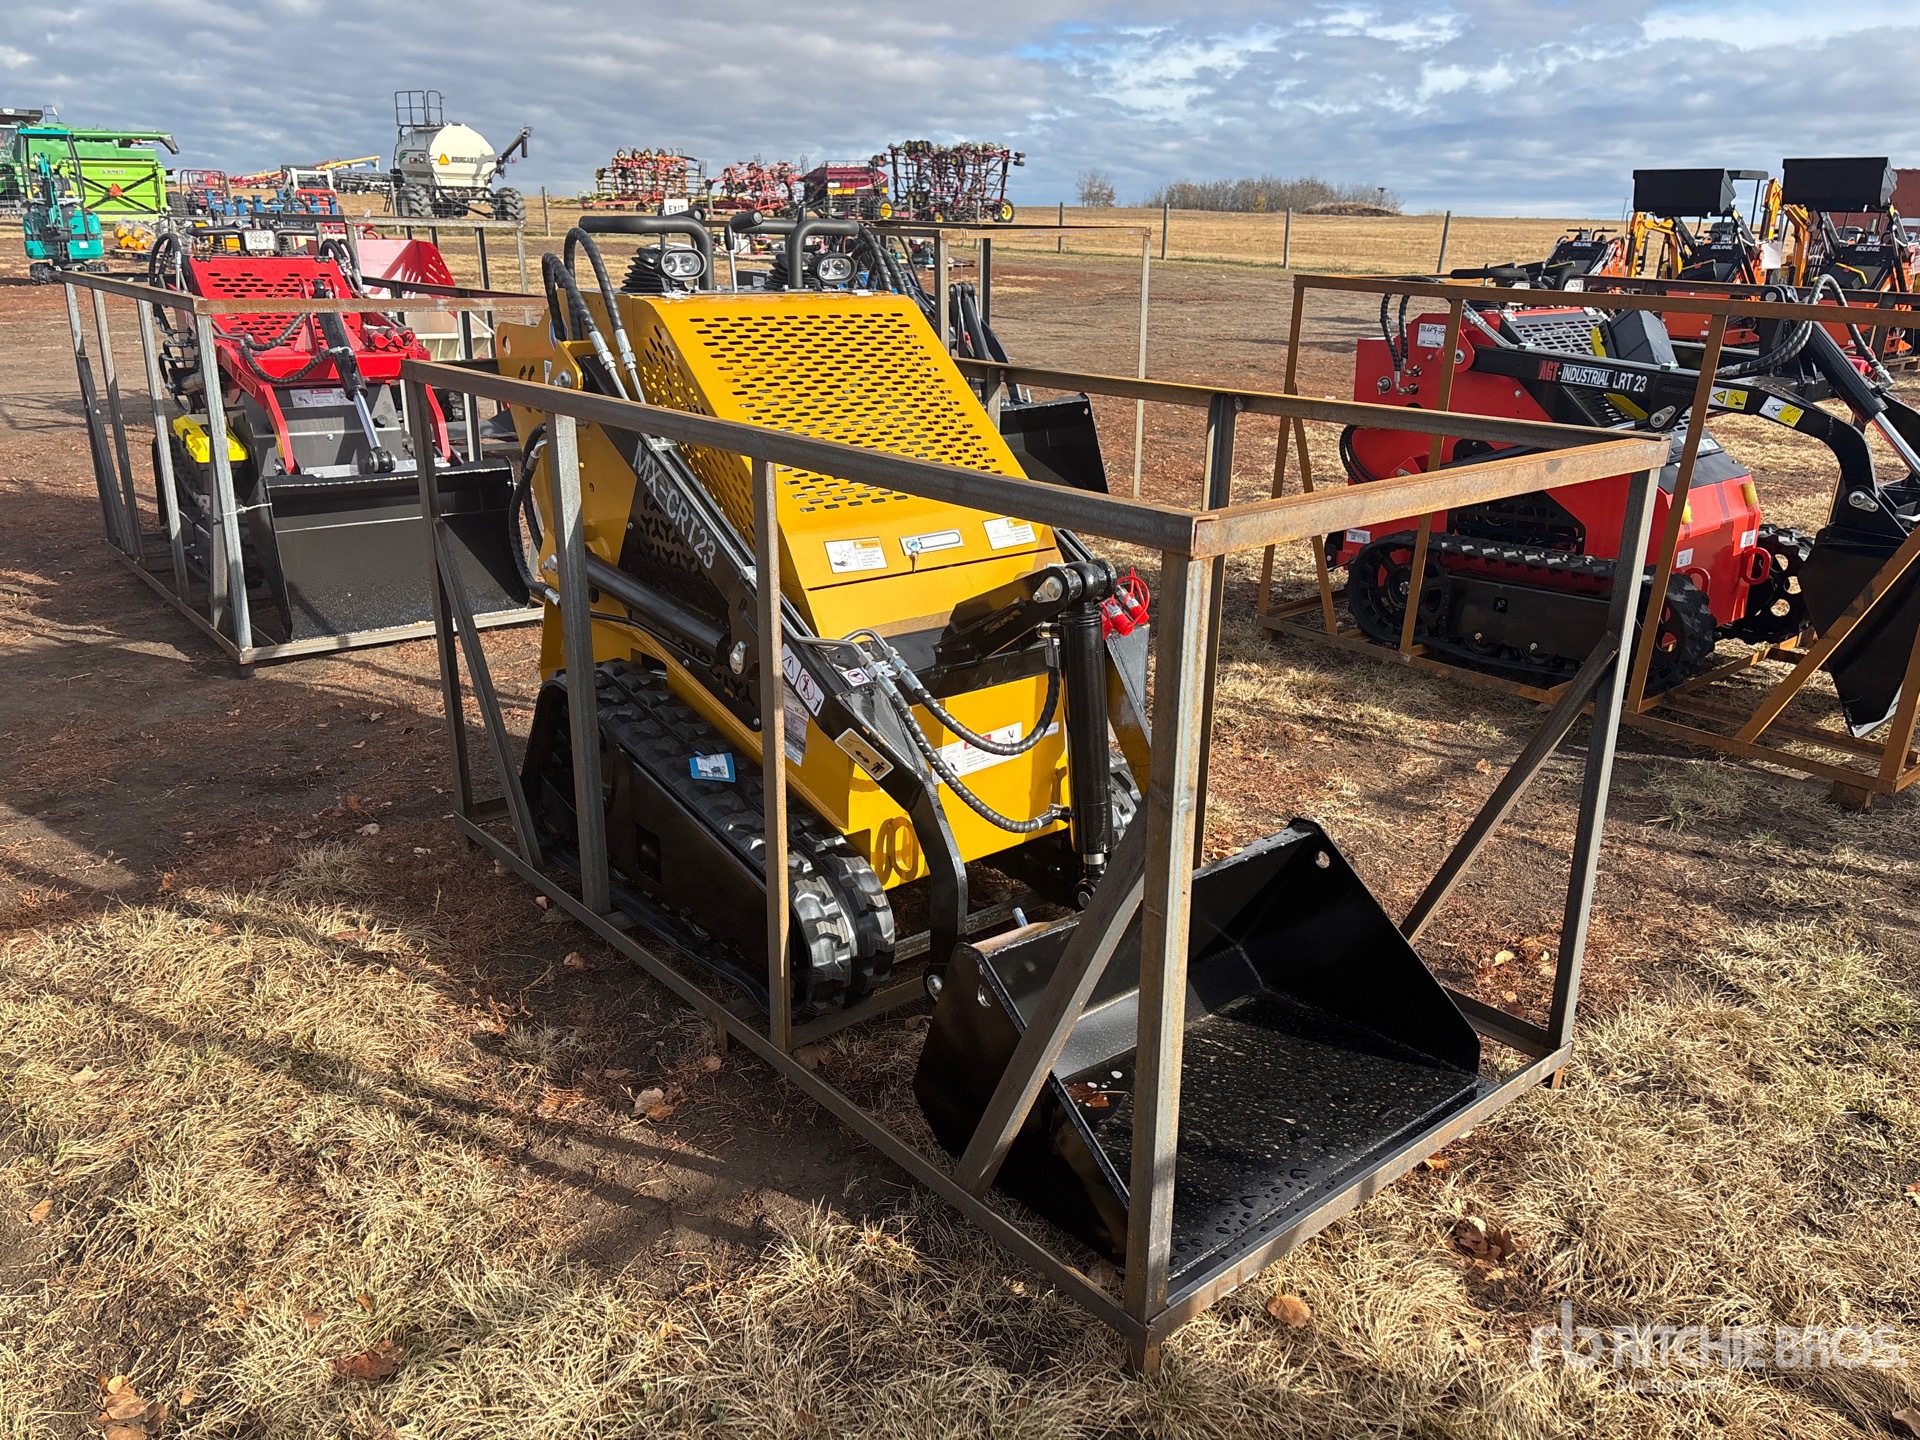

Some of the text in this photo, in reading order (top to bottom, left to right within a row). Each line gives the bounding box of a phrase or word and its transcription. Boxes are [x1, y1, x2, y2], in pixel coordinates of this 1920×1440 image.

[668, 205, 684, 213] EXIT
[1538, 360, 1648, 393] AGT INDUSTRIAL LRT 23
[632, 440, 717, 569] MX-CRT23
